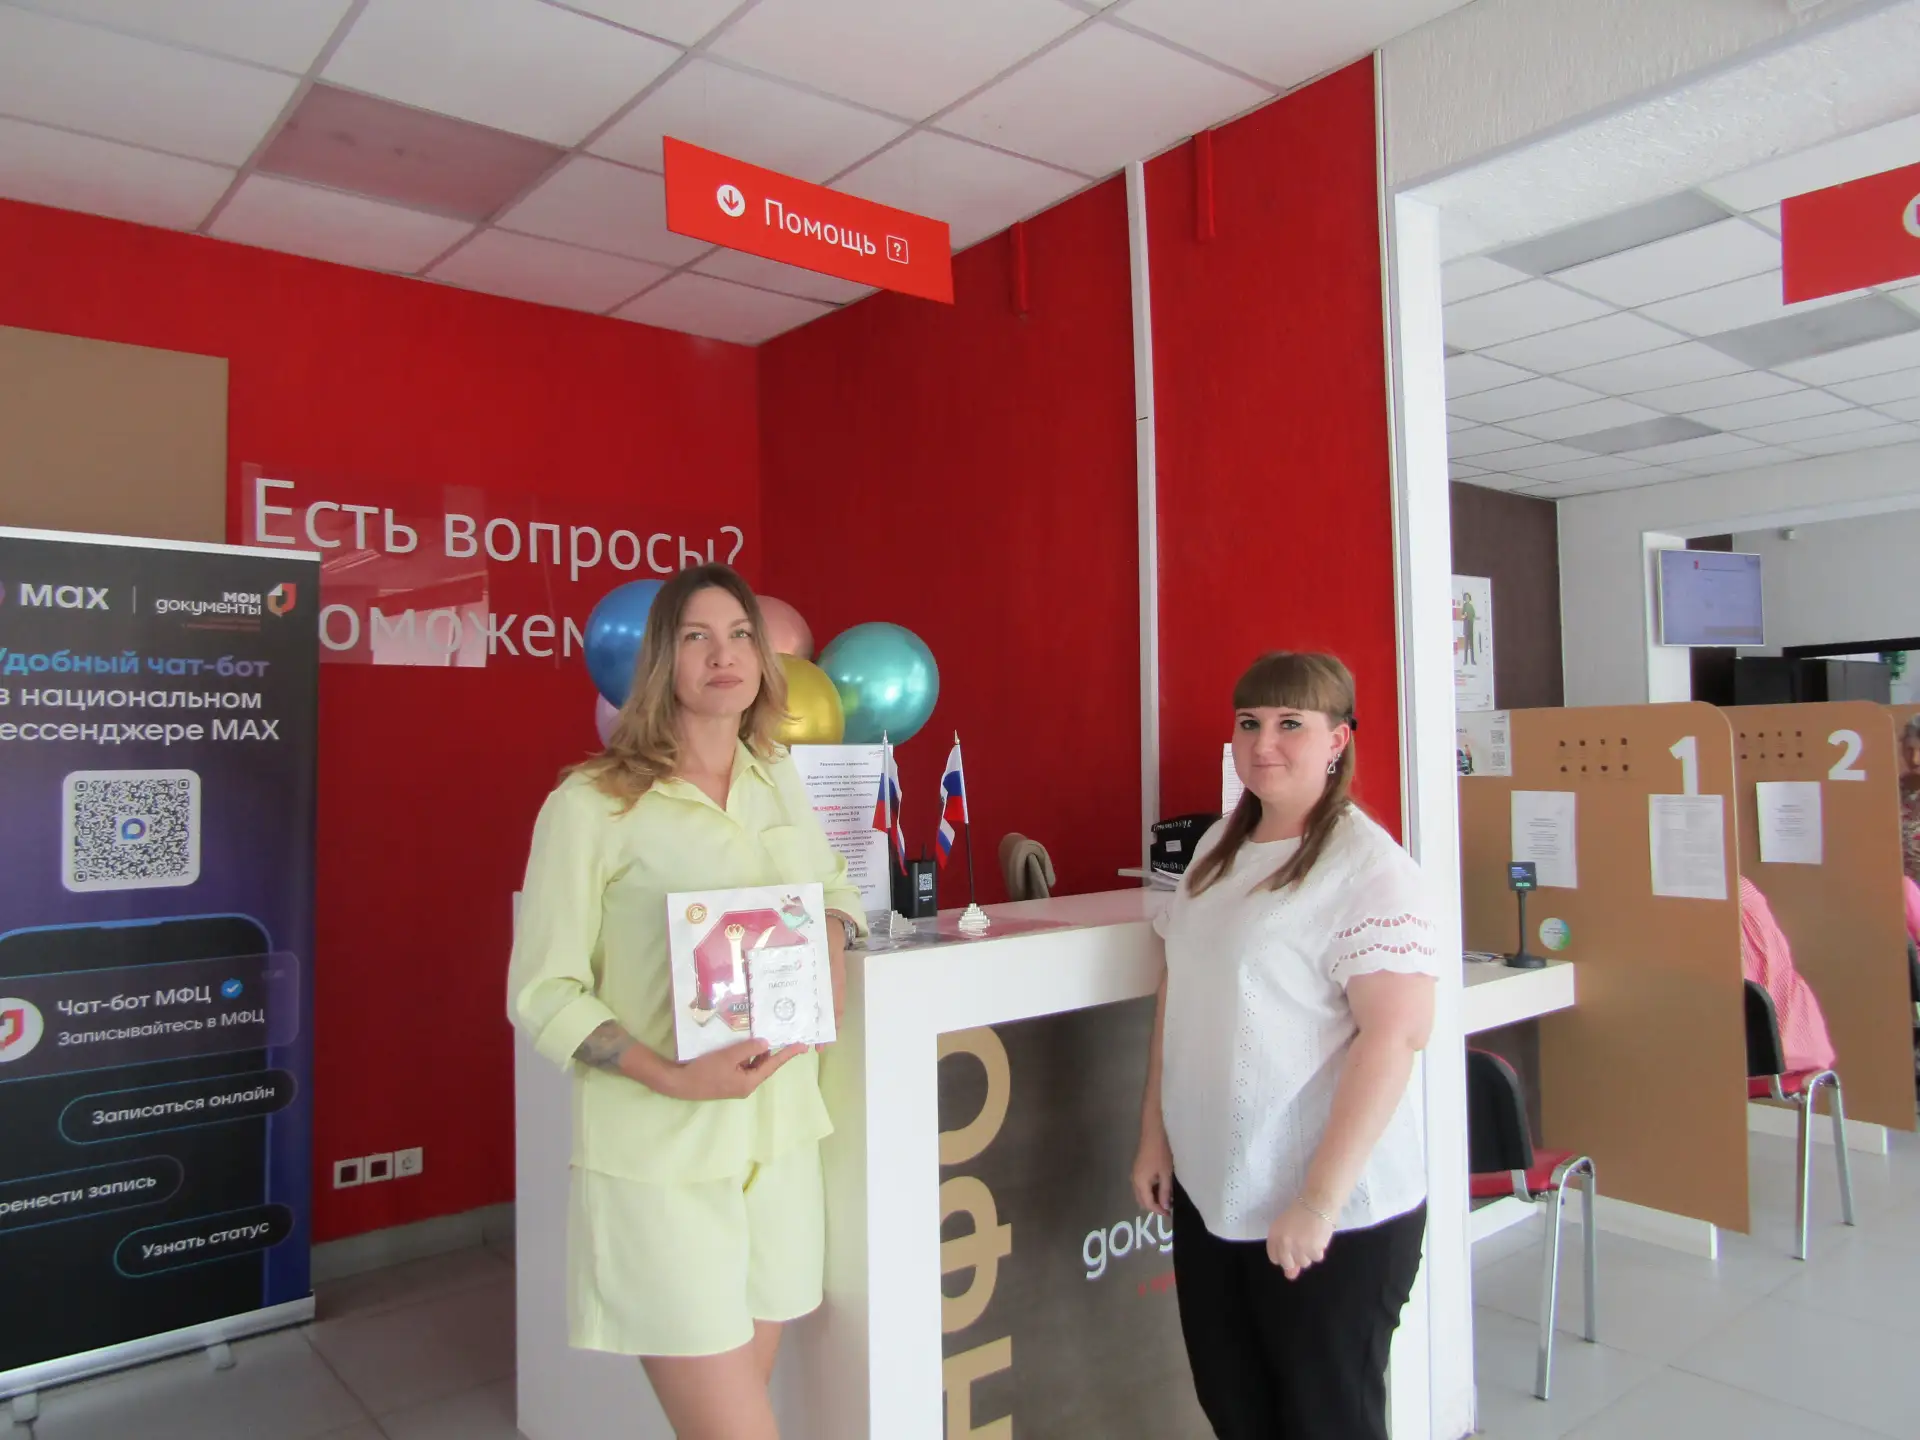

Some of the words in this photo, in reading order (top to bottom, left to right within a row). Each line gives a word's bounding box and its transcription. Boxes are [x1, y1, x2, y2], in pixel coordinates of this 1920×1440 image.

[764, 198, 877, 257] Помощь
[255, 477, 419, 554] Есть
[444, 513, 744, 582] вопросы?
[155, 598, 262, 616] документы
[319, 603, 585, 658] оможе
[147, 654, 271, 678] чат-бот
[21, 687, 263, 711] национальном
[0, 721, 205, 746] ессенджере
[1668, 735, 1699, 795] 1
[1826, 729, 1867, 782] 2
[57, 992, 152, 1017] Чат-бот
[155, 985, 213, 1006] МФЦ
[58, 1016, 203, 1046] Записывайтесь
[207, 1016, 217, 1027] в
[220, 1008, 265, 1027] МФЦ
[92, 1097, 205, 1126] Записаться
[209, 1084, 276, 1107] онлайн
[0, 1189, 83, 1217] ренести
[88, 1176, 157, 1198] запись
[142, 1234, 206, 1260] Узнать
[209, 1221, 270, 1245] статус
[1082, 1211, 1173, 1279] доку
